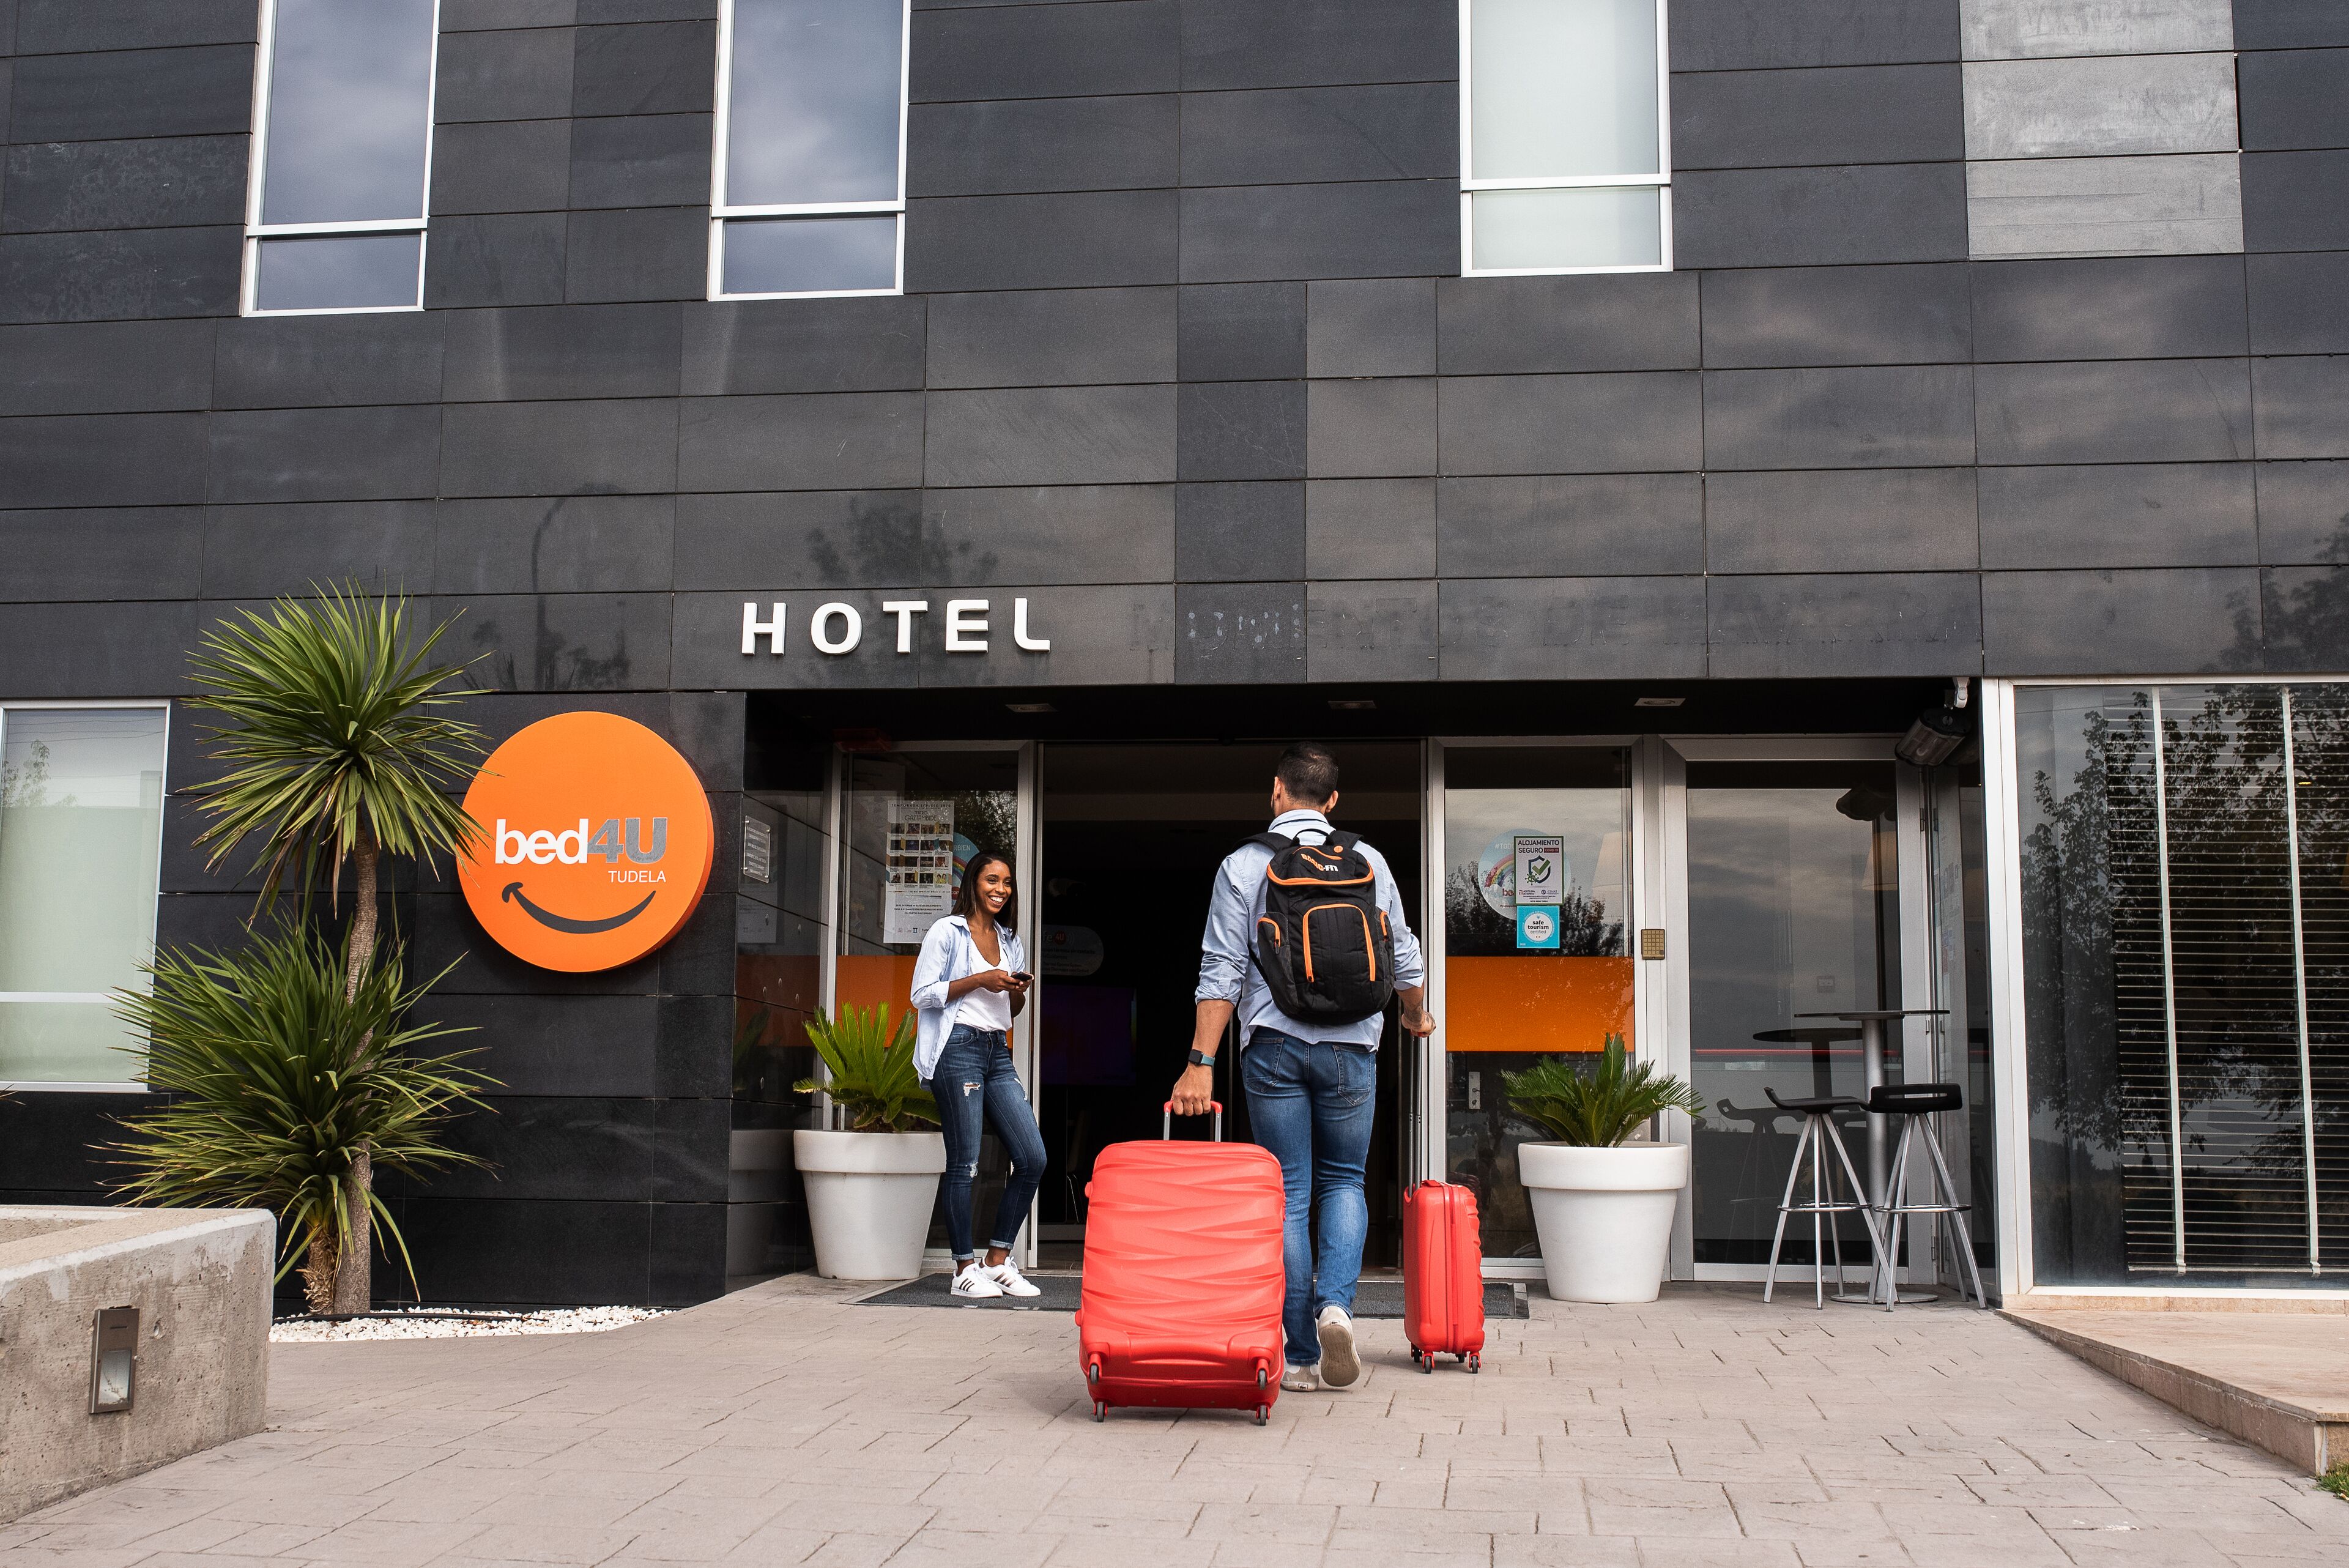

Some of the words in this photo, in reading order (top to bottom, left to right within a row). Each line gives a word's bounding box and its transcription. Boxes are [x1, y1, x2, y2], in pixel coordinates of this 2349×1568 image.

[741, 597, 1051, 656] HOTEL
[495, 817, 668, 864] bed4U
[608, 870, 667, 883] TUDELA
